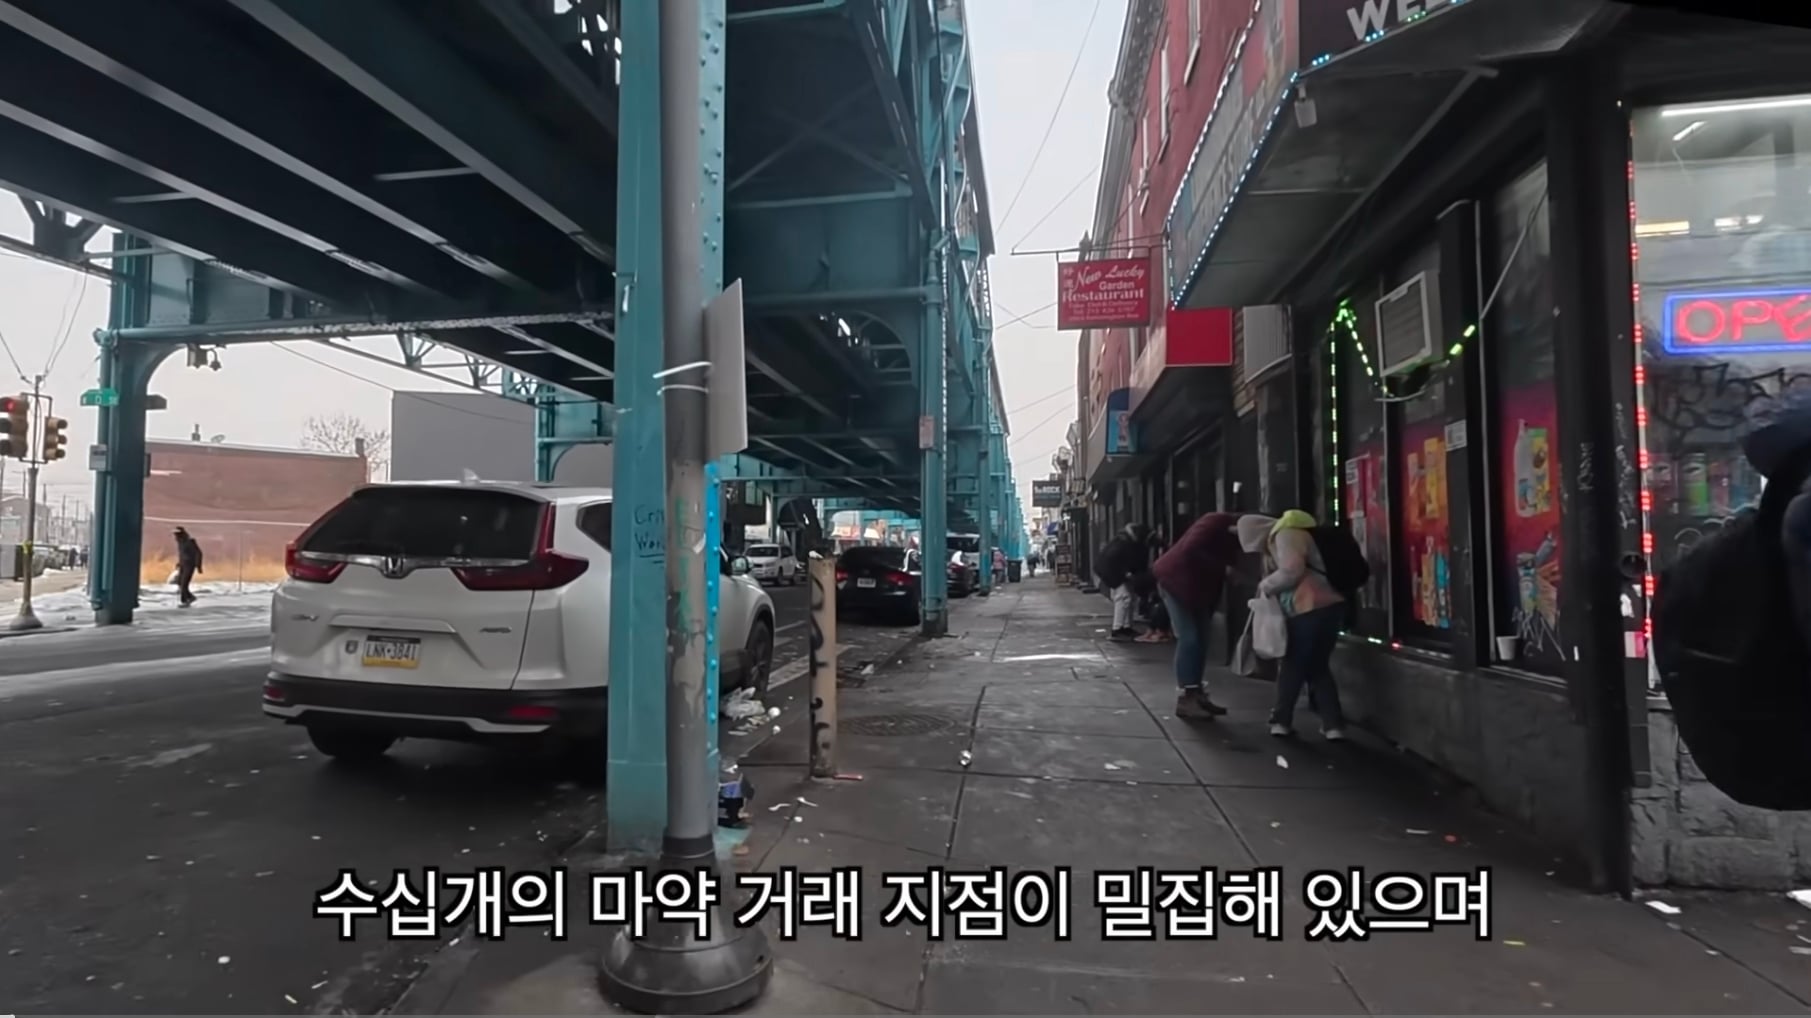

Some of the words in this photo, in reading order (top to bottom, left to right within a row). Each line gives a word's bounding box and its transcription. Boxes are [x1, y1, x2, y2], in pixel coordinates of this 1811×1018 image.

[1347, 0, 1447, 41] WE
[1072, 265, 1102, 292] New
[1105, 264, 1145, 280] Lucky
[1099, 281, 1135, 291] Garden
[1062, 289, 1144, 303] Restaurant
